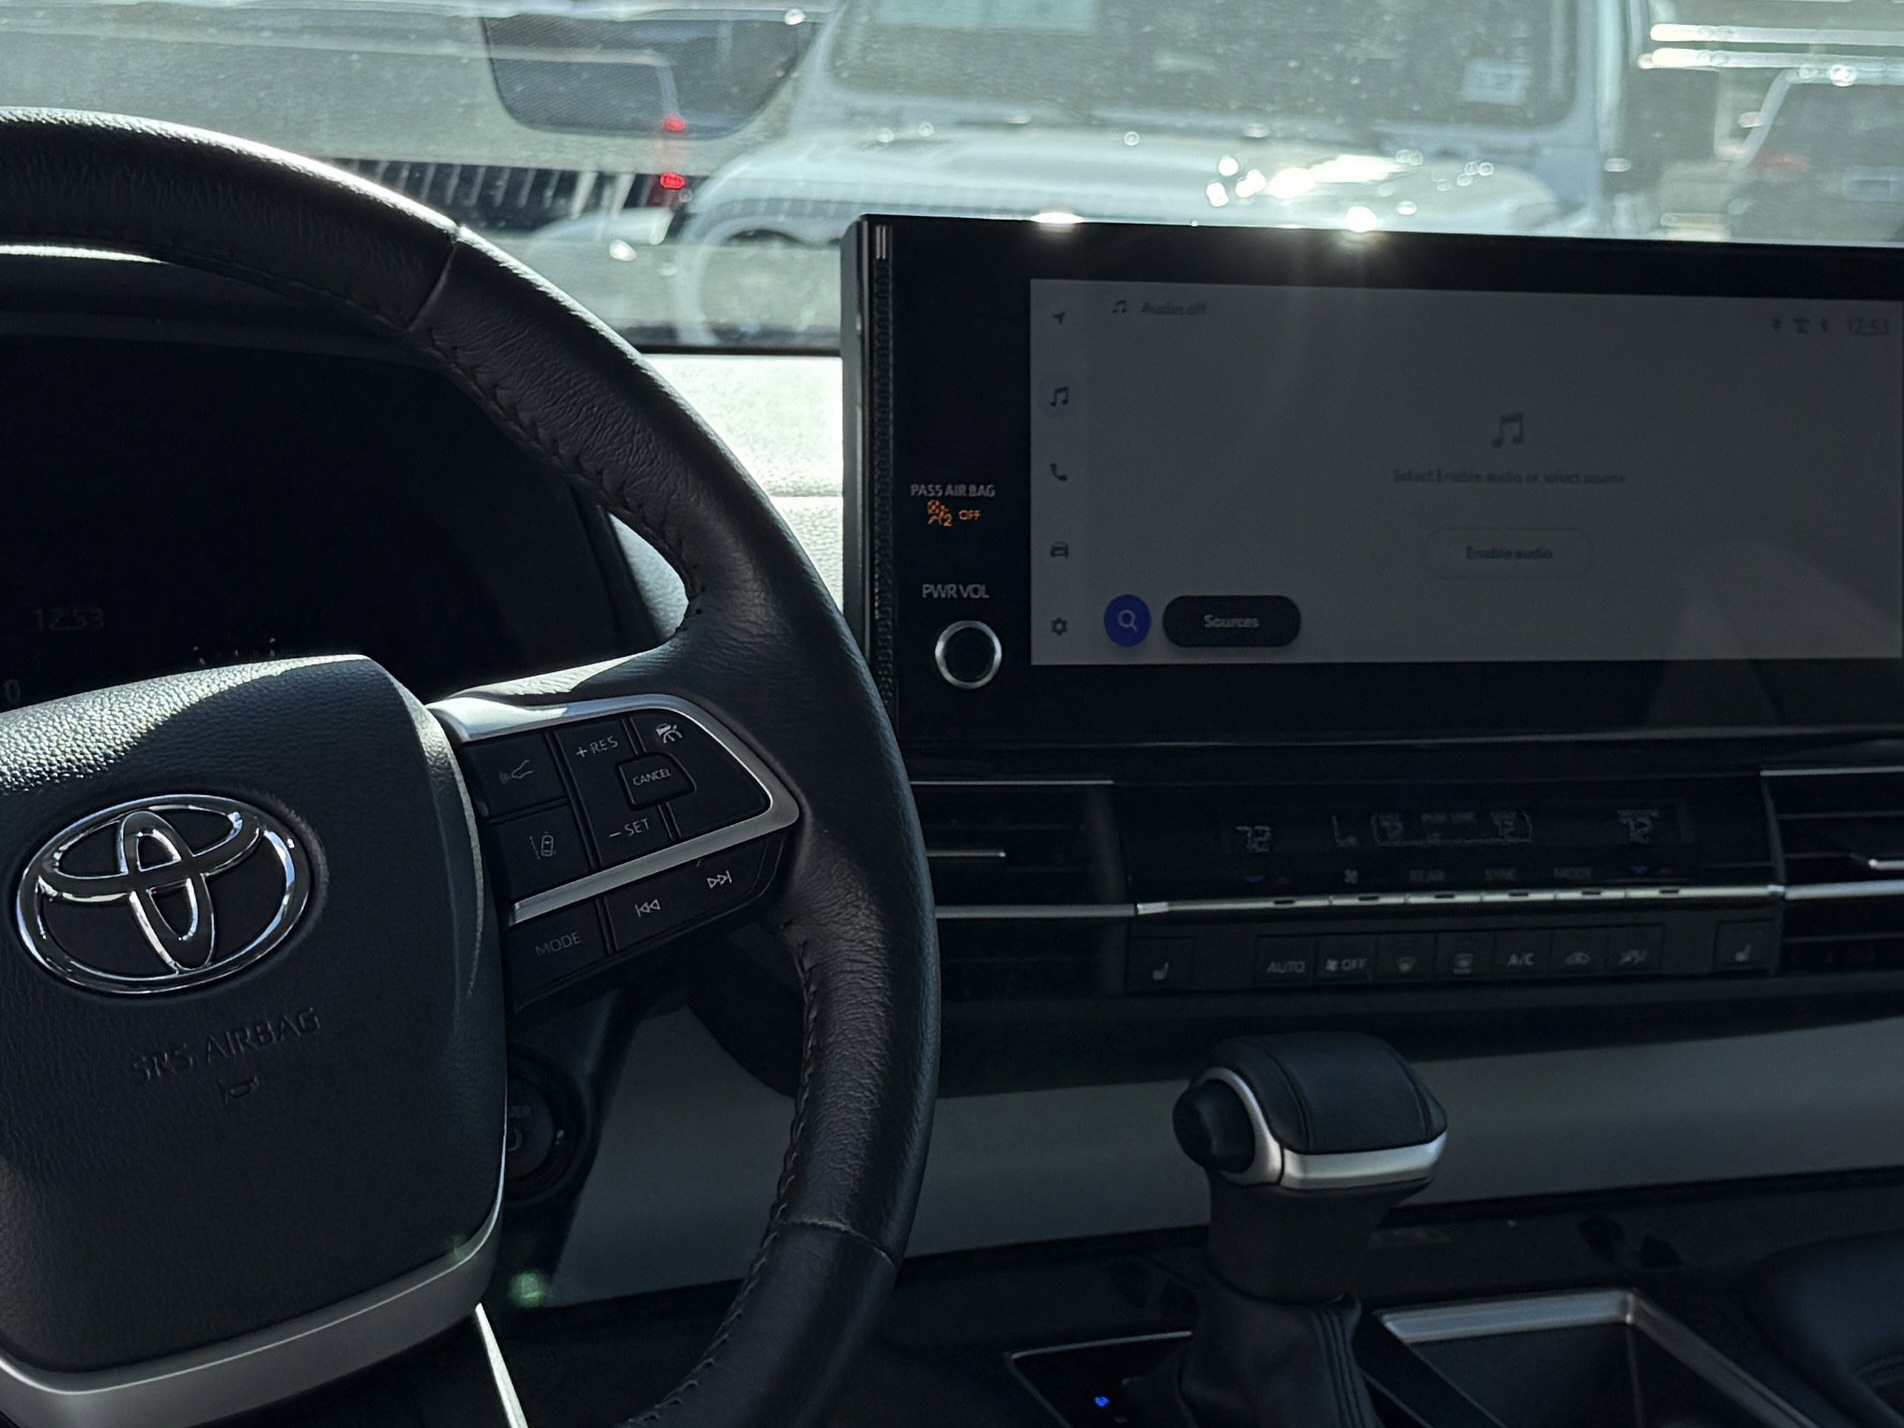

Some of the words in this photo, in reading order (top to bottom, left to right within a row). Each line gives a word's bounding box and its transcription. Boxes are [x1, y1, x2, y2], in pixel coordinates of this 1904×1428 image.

[910, 483, 943, 498] PASS
[958, 509, 982, 522] OFF
[921, 582, 955, 600] PWR
[955, 583, 991, 600] VOL
[1202, 613, 1261, 629] Sources
[631, 767, 673, 787] CANCEL
[534, 930, 582, 957] MODE
[1266, 960, 1306, 974] AUTO
[1340, 957, 1368, 972] OFF
[1507, 952, 1534, 967] A/C
[132, 1042, 194, 1082] SRS
[206, 1006, 321, 1064] AIRBAG
